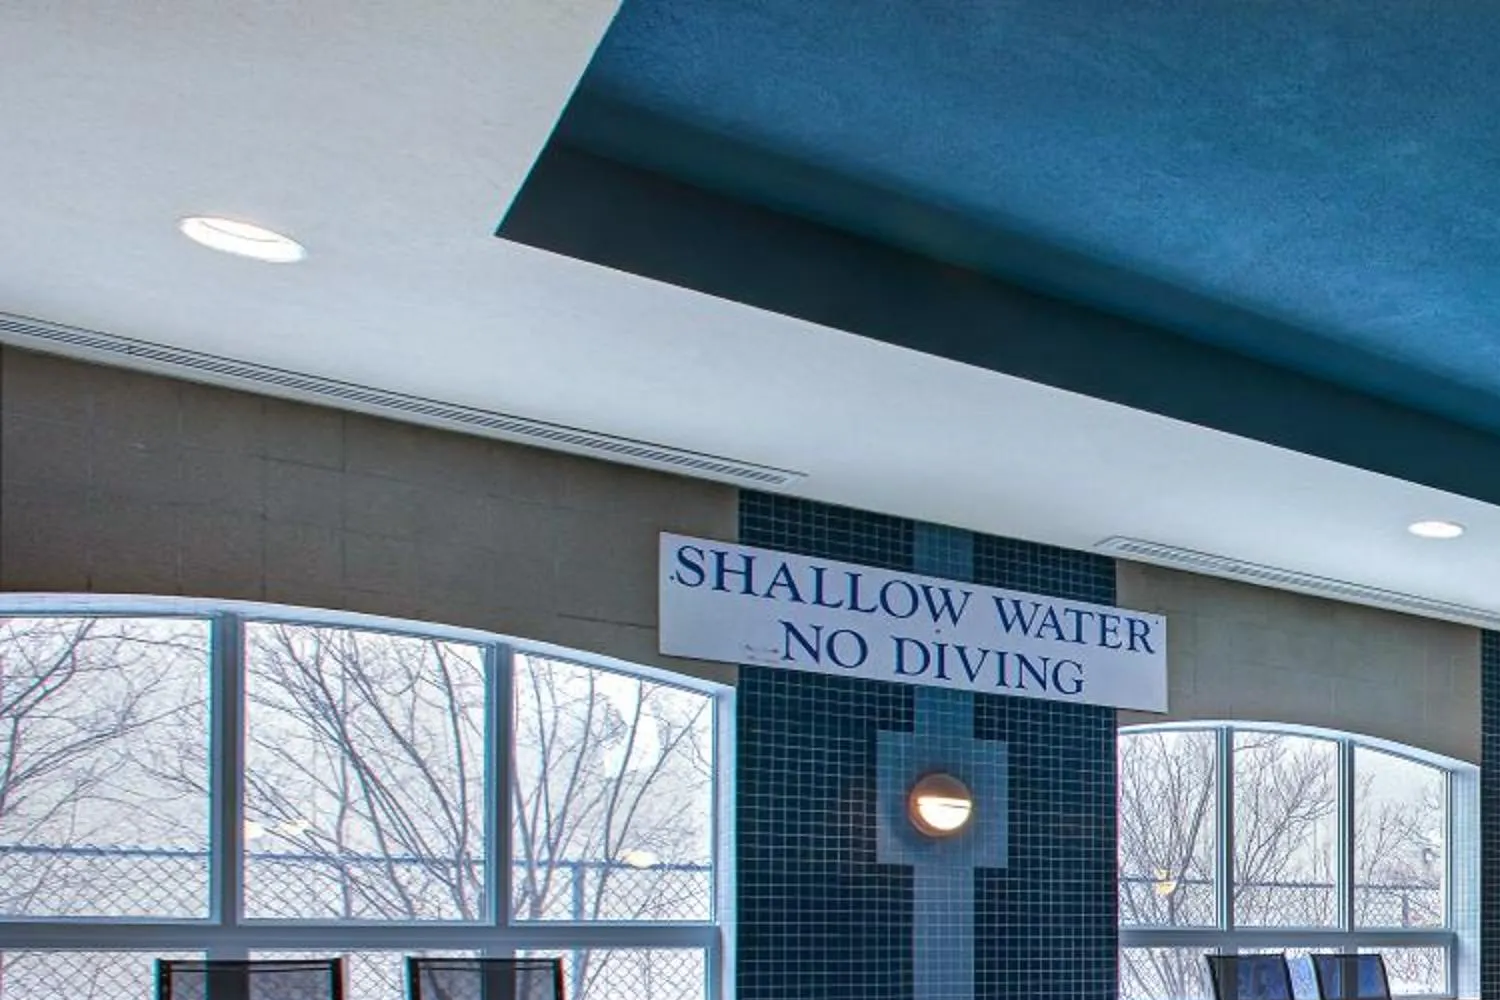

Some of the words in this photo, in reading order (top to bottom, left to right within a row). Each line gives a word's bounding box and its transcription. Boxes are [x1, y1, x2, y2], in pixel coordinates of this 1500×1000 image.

[675, 545, 973, 628] SHALLOW
[991, 595, 1155, 654] WATER
[778, 619, 869, 669] NO
[889, 635, 1084, 695] DIVING
